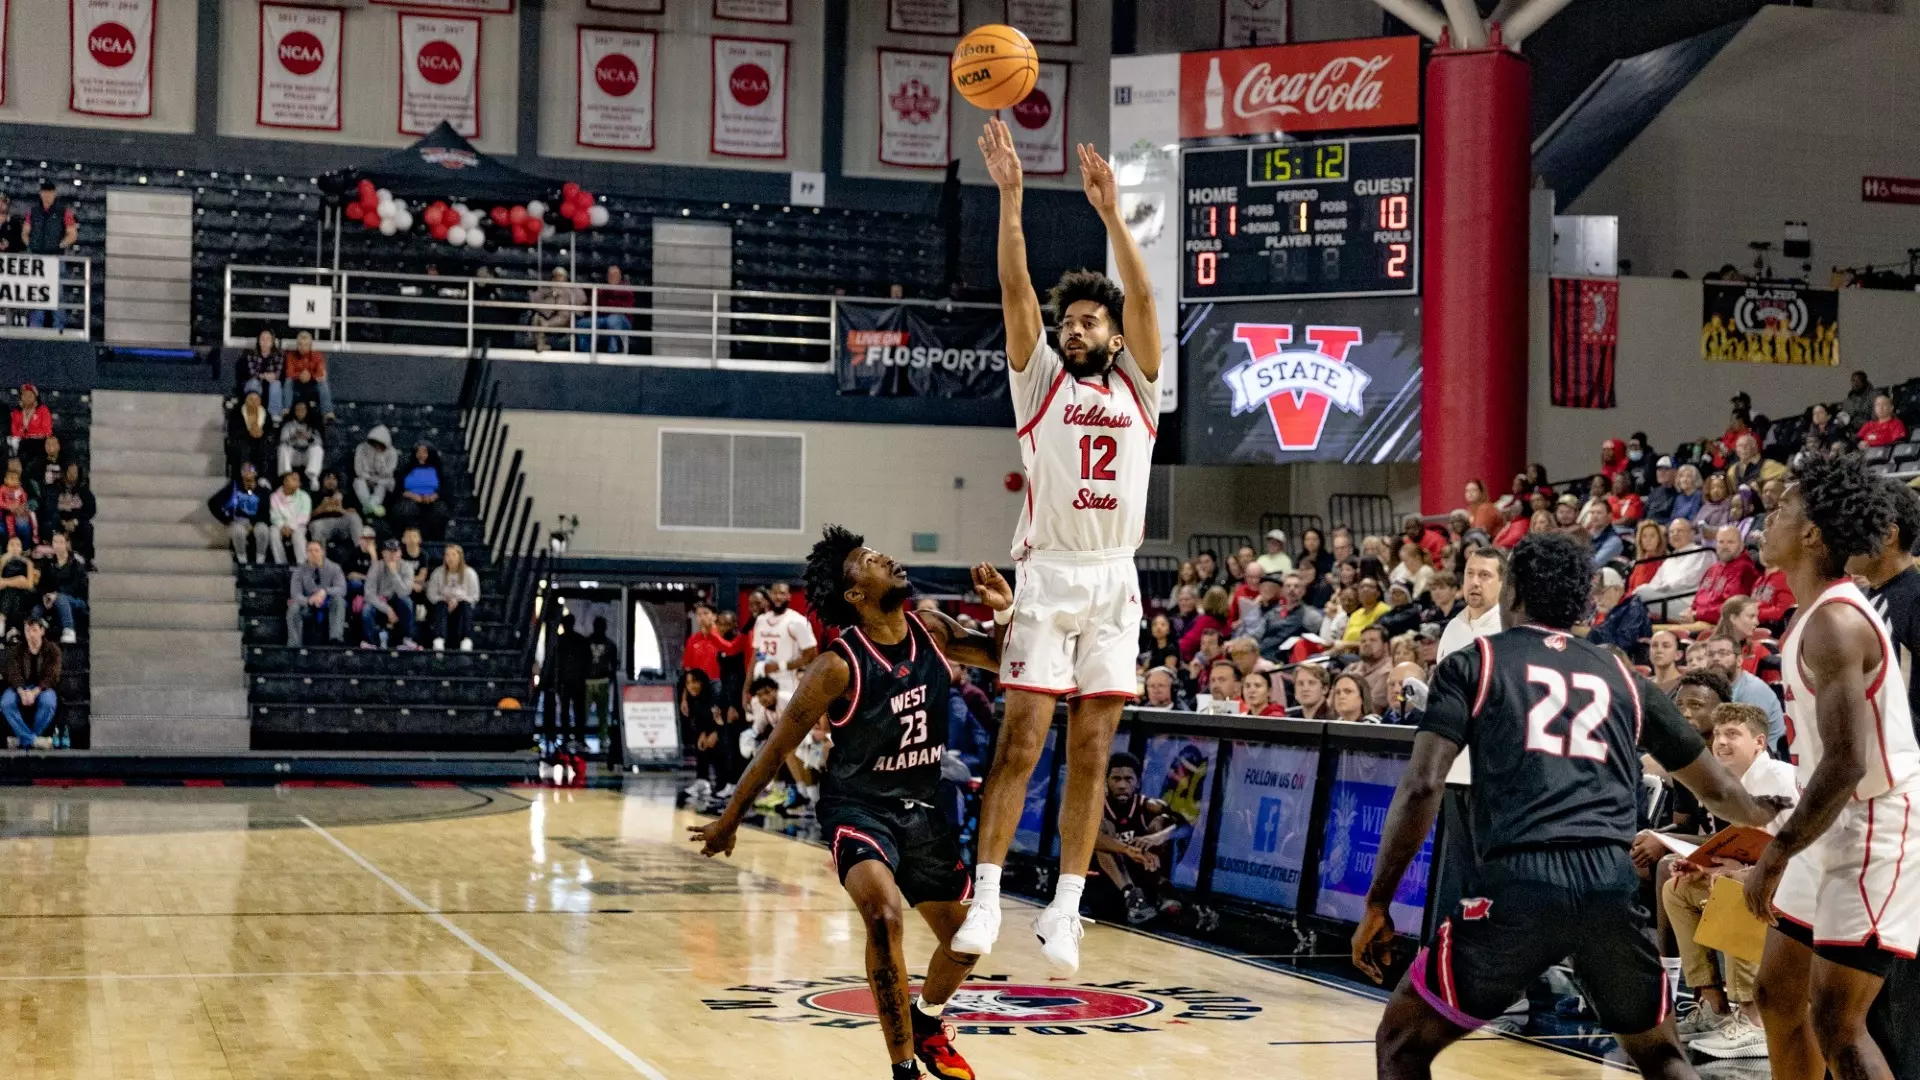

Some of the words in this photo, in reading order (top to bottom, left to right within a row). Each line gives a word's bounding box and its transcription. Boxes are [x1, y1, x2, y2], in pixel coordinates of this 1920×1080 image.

[90, 36, 136, 55] NCAA
[280, 44, 322, 62] NCAA
[419, 55, 460, 71] NCAA
[596, 67, 637, 83] NCAA
[731, 77, 769, 92] NCAA
[957, 66, 992, 88] NCAA
[1233, 53, 1394, 119] Coca-Cola
[1264, 146, 1343, 181] 15:12
[1188, 187, 1238, 204] HOME
[1276, 189, 1319, 203] PERIOD
[1353, 177, 1414, 196] GUEST
[1247, 204, 1275, 217] POSS
[1320, 201, 1348, 213] POSS
[1379, 196, 1408, 230] 10
[1209, 204, 1238, 237] 11
[1248, 221, 1280, 234] BONUS
[1313, 218, 1348, 231] BONUS
[1186, 238, 1223, 251] FOULS
[1265, 234, 1312, 249] PLAYER
[1314, 233, 1347, 246] FOUL
[1373, 230, 1412, 243] FOULS
[1197, 252, 1217, 286] 0
[1386, 244, 1408, 279] 2
[0, 283, 50, 303] ALES
[1744, 288, 1798, 300] BLAZER
[306, 299, 316, 313] N
[854, 333, 881, 346] LIVE
[882, 334, 902, 346] ON
[865, 345, 1007, 372] FLOSPORTS
[1257, 361, 1342, 390] STATE
[1063, 403, 1133, 429] Valdosta
[1078, 434, 1118, 481] 12
[1072, 487, 1118, 511] State
[890, 684, 927, 715] WEST
[1525, 663, 1612, 764] 22
[899, 709, 928, 751] 23
[872, 743, 944, 771] ALABAM
[1244, 767, 1277, 787] FOLLOW
[1278, 772, 1291, 788] US
[1291, 774, 1308, 791] ON
